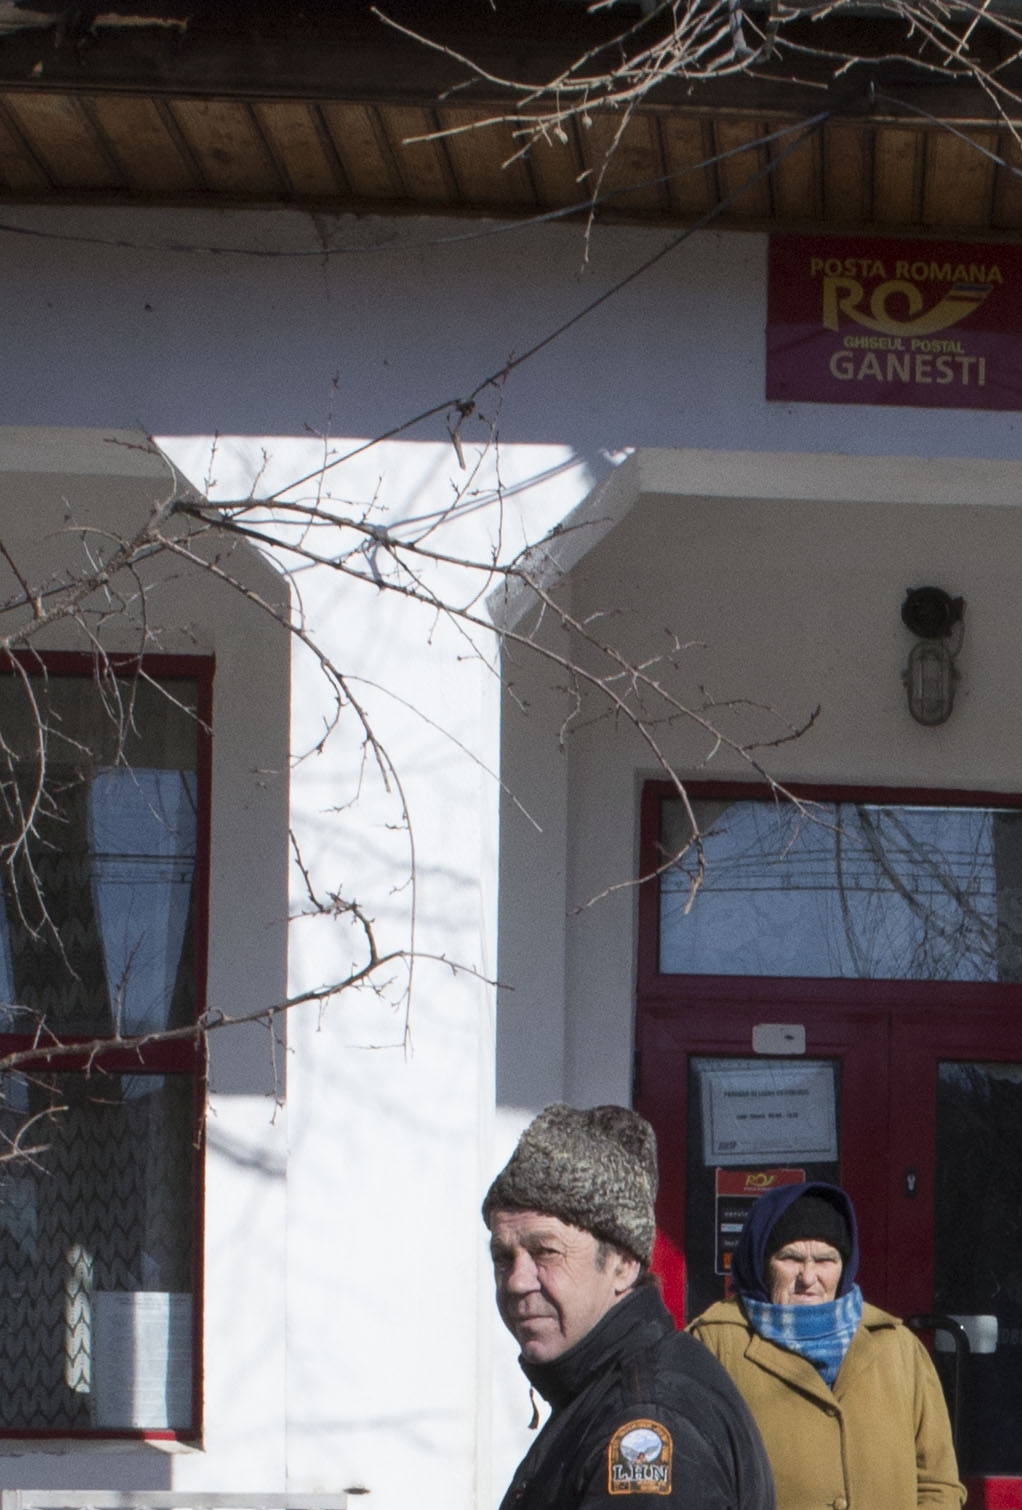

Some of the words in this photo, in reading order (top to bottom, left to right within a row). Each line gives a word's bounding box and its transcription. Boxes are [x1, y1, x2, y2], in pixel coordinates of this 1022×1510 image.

[810, 257, 886, 278] POSTA
[896, 260, 1003, 283] ROMANA
[843, 336, 905, 350] GHISEUL
[911, 339, 964, 353] POSTAL
[830, 350, 986, 386] GANESTI
